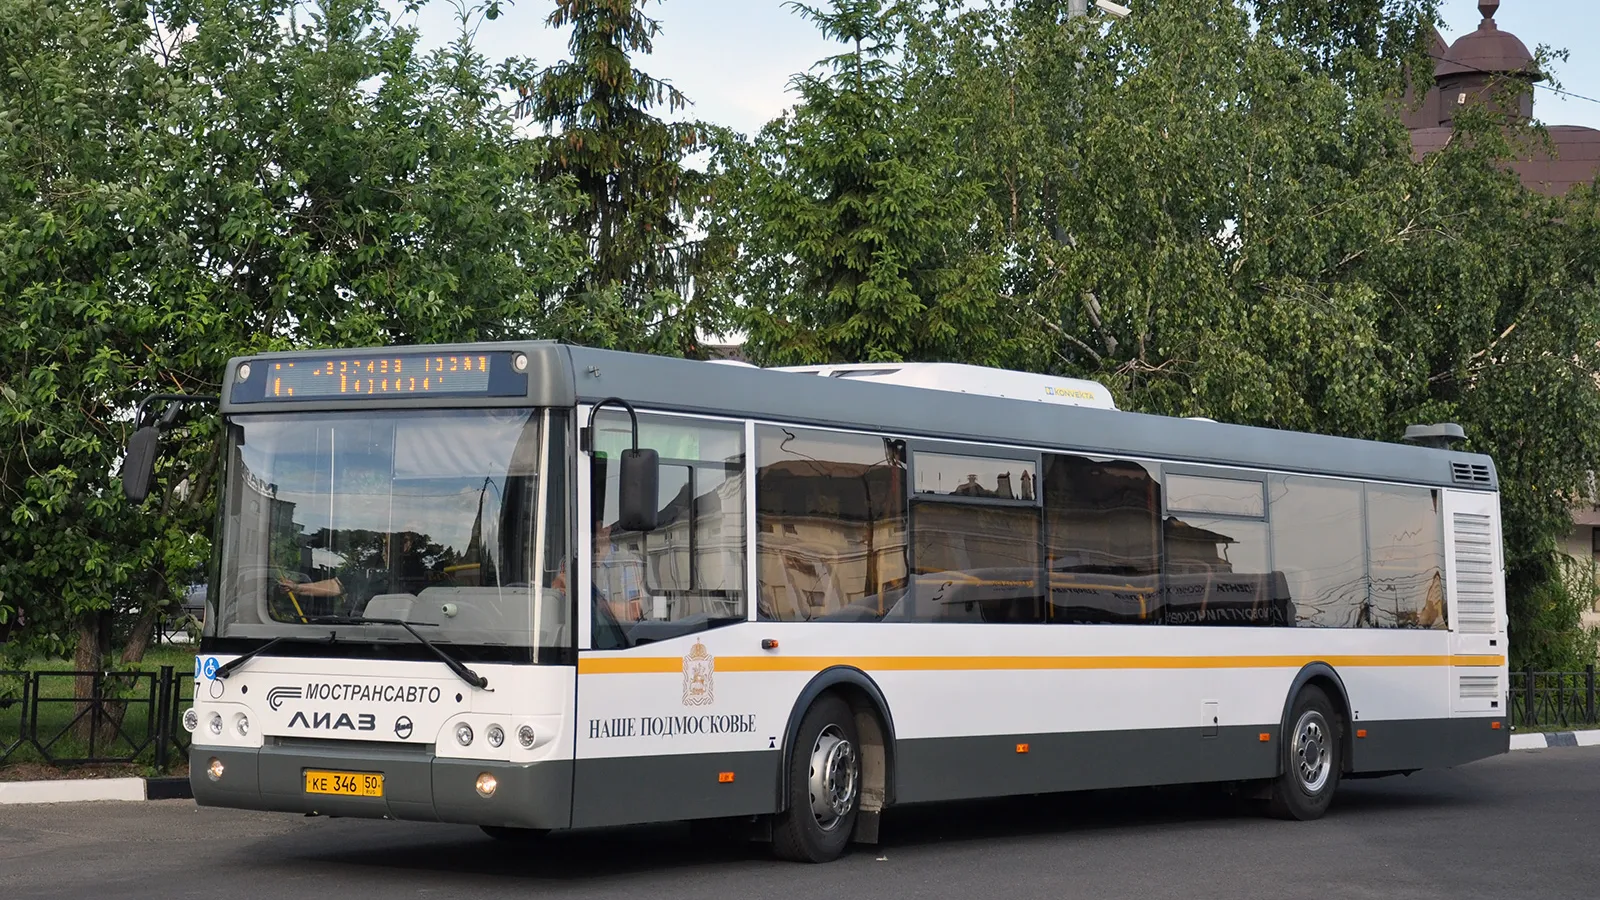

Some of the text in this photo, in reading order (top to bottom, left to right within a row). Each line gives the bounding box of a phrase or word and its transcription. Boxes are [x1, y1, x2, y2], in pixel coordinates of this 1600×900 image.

[1054, 387, 1095, 400] KONVEKTA
[305, 683, 441, 703] МОСТРАНСАВТО
[287, 711, 376, 731] ЛИАЗ
[589, 714, 757, 739] НАШЕ ПОДМОСКОВЬЕ
[333, 775, 357, 792] 346
[364, 776, 378, 789] 50
